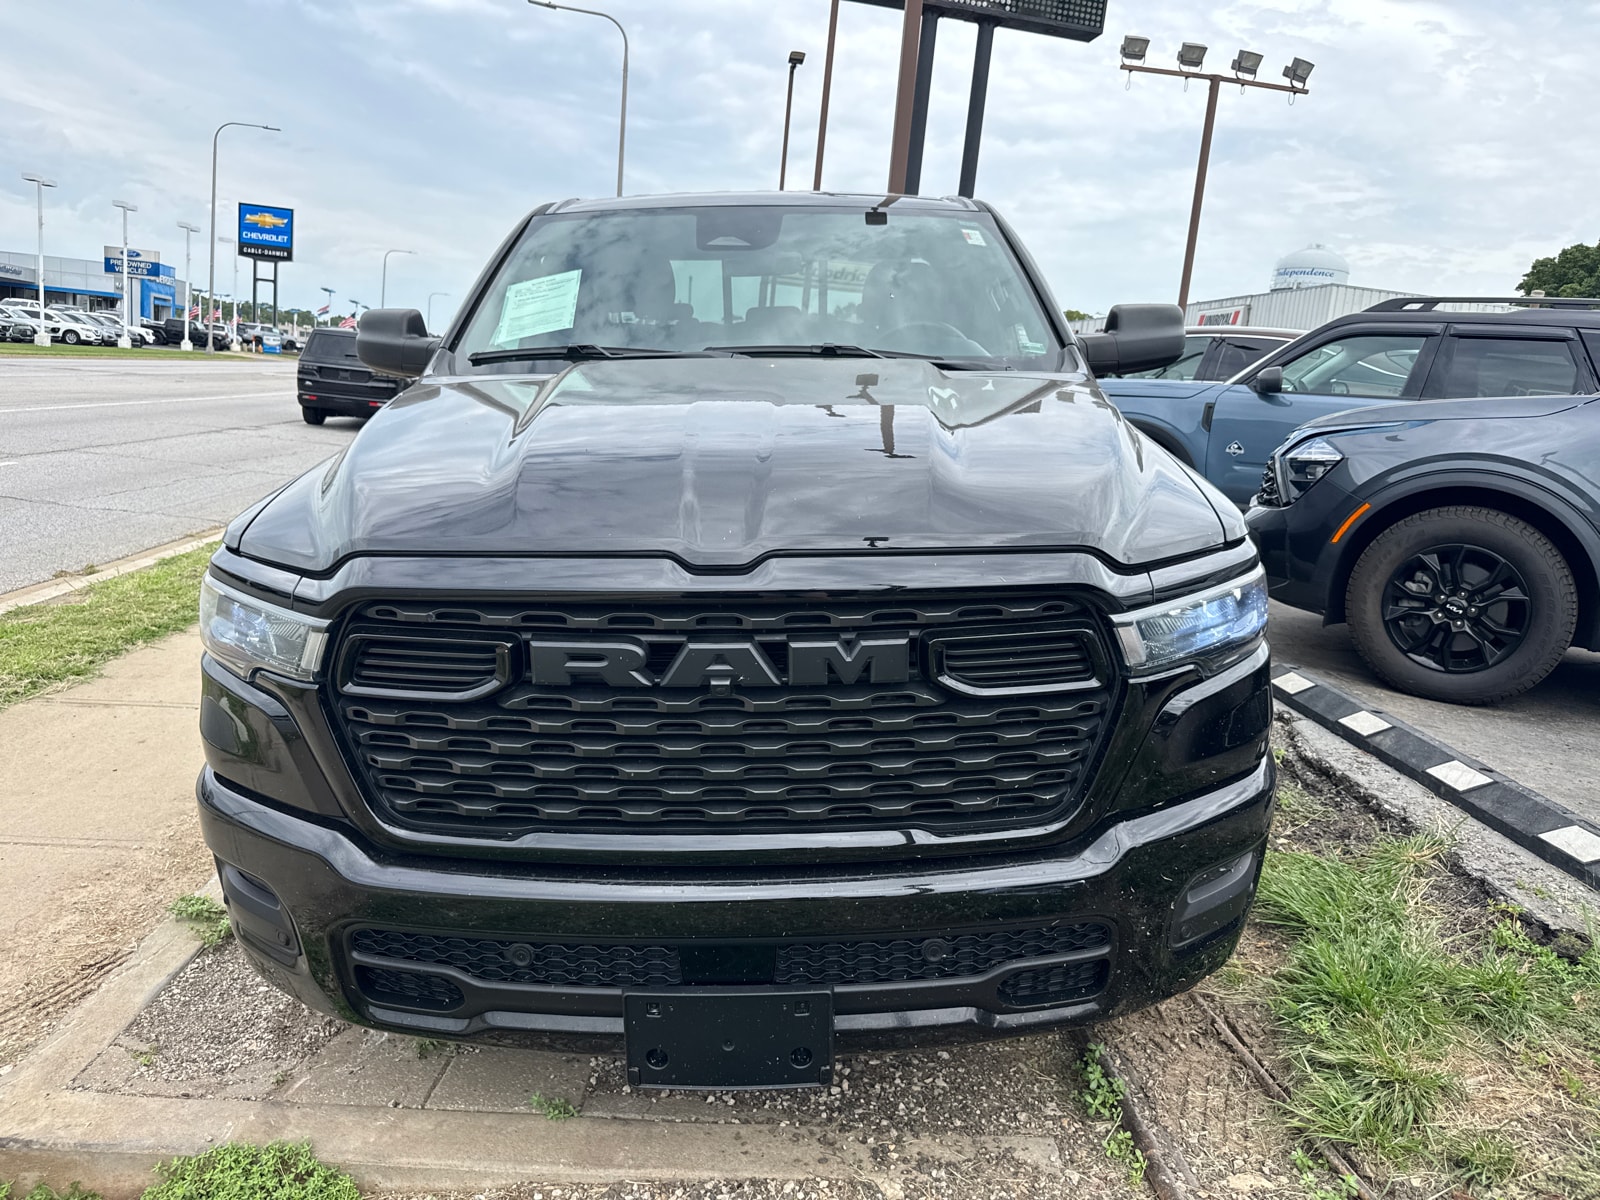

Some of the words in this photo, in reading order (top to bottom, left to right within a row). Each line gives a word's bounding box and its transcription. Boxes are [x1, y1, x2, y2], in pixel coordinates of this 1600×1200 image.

[243, 231, 288, 243] CHEVROLET
[110, 259, 152, 269] PREOWNED
[114, 266, 148, 275] VEICLES
[1203, 312, 1232, 326] UNIROYAL
[529, 634, 910, 687] RAM
